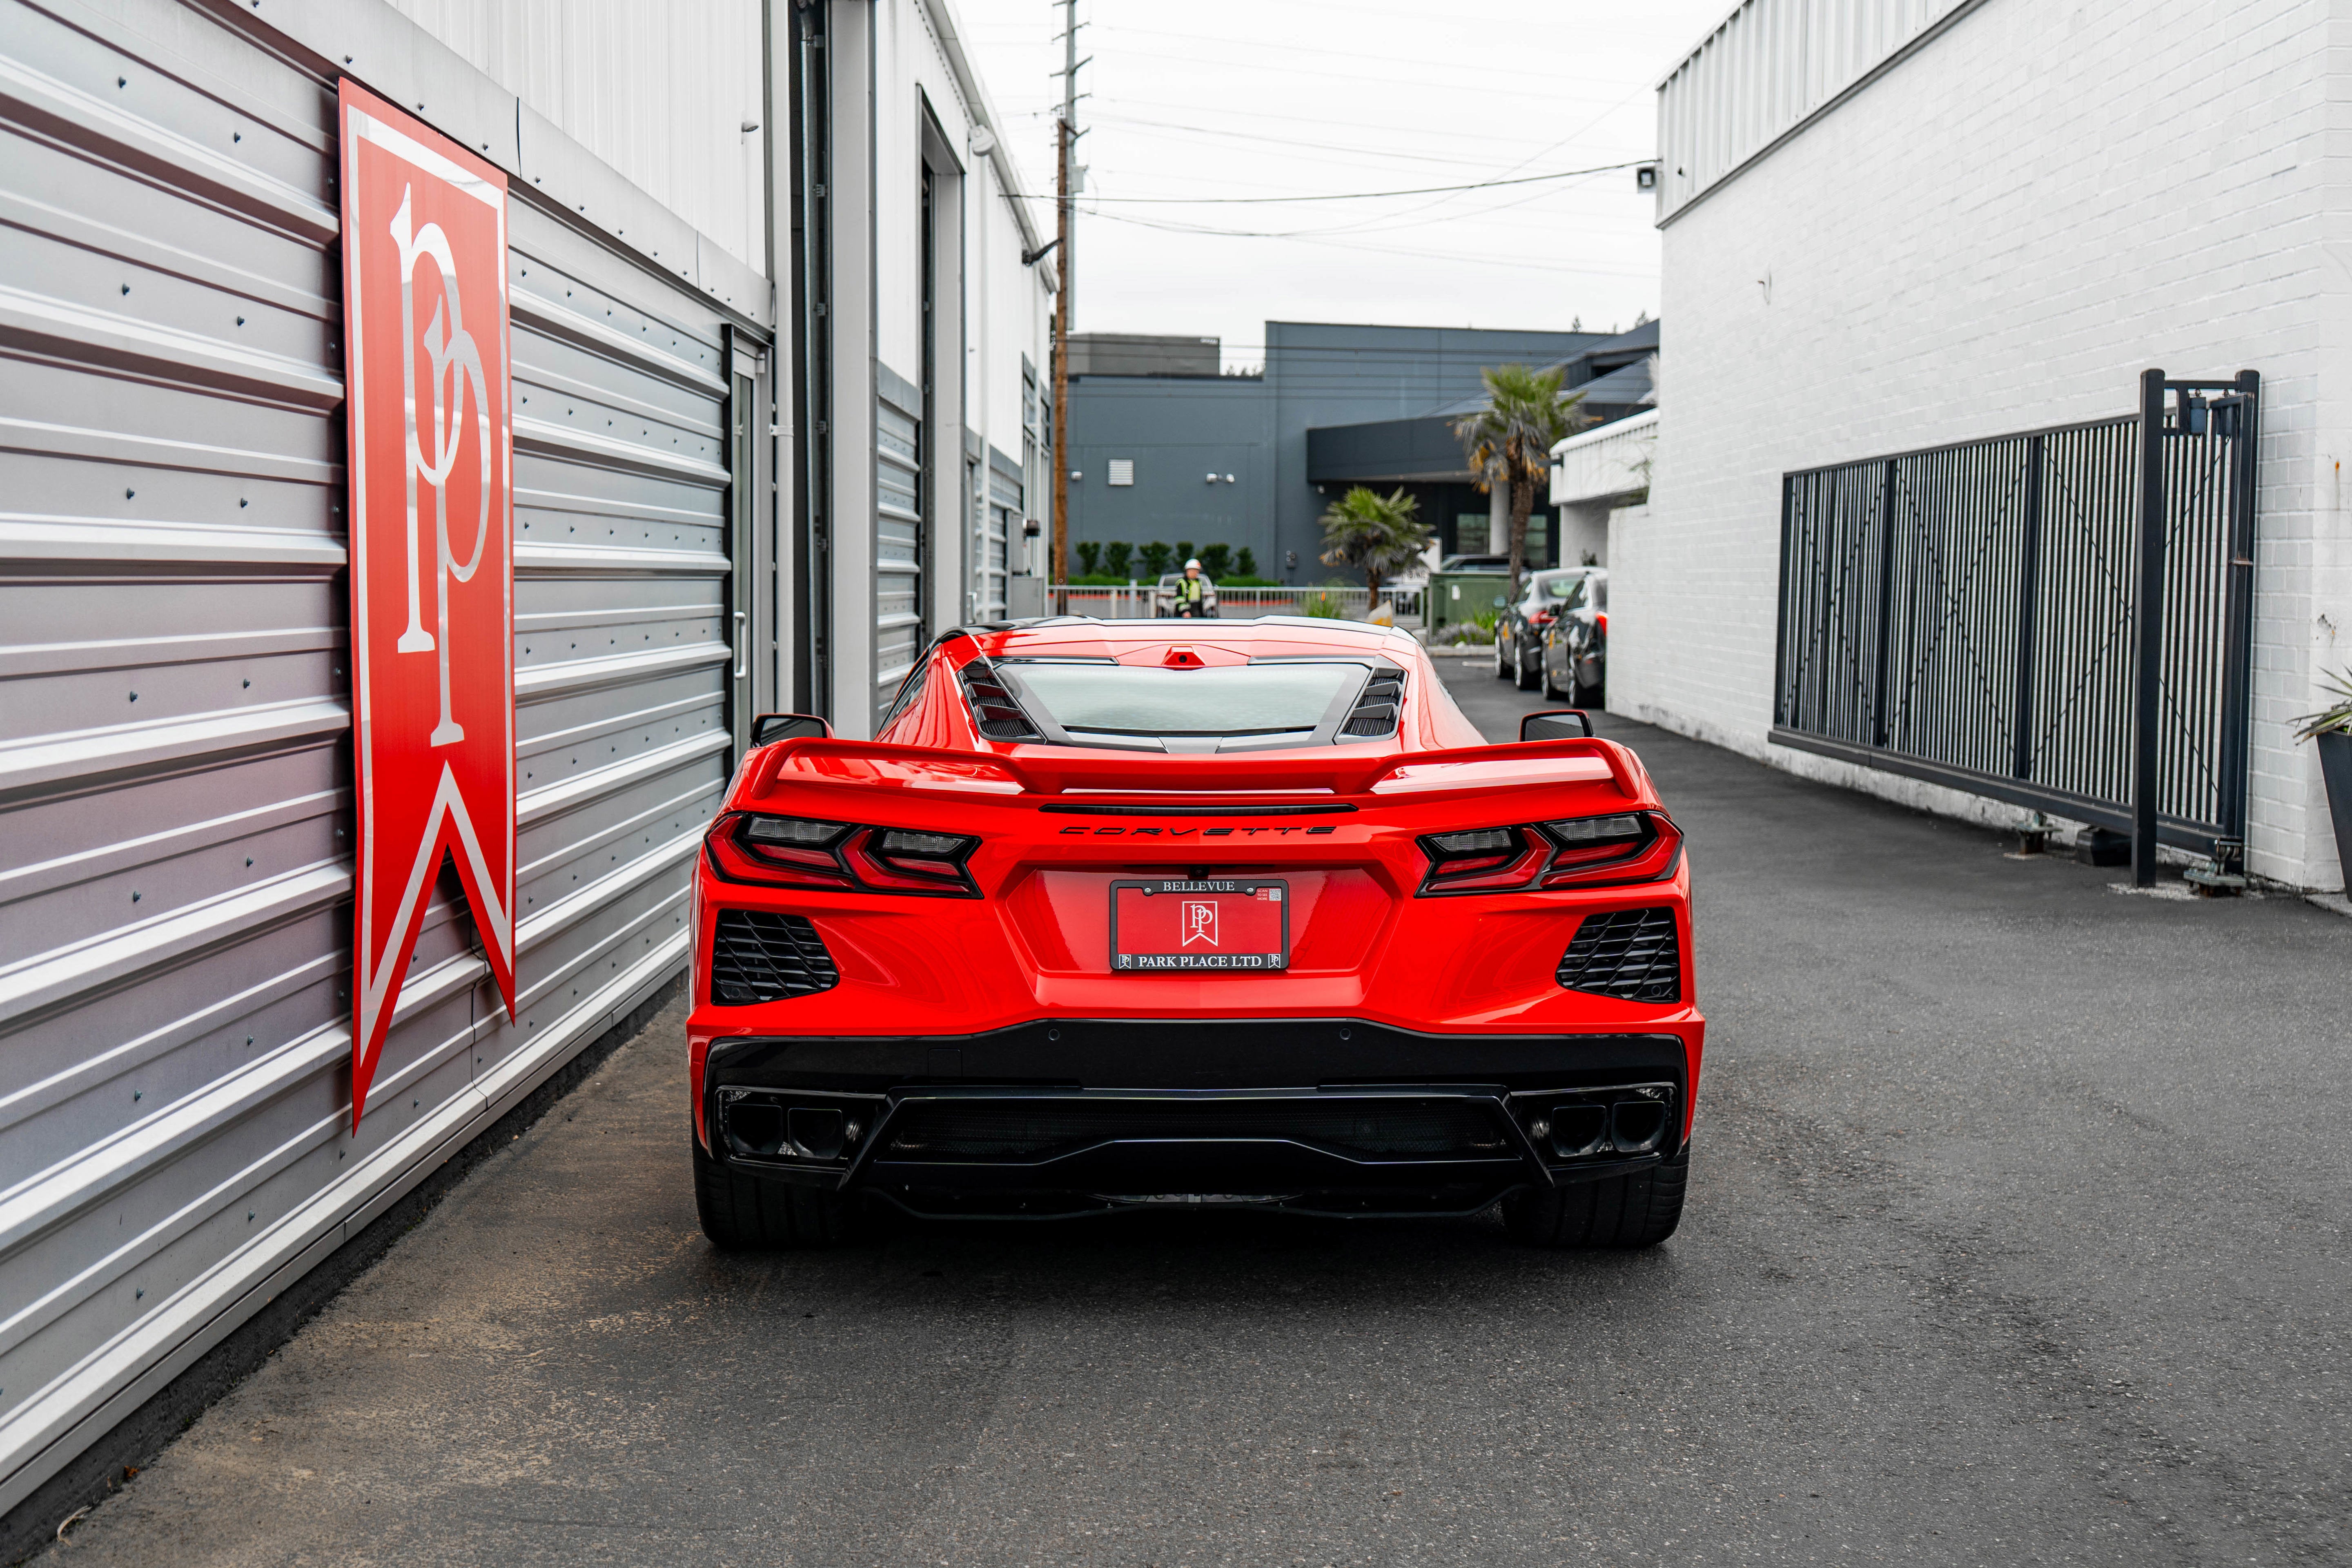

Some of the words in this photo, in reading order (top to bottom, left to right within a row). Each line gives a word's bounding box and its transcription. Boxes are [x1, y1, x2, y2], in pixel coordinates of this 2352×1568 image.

[1059, 826, 1337, 836] CORVETTE
[1163, 881, 1235, 891] BELLEVUE
[1138, 956, 1176, 967] PARK
[1179, 956, 1228, 967] PLACE
[1231, 956, 1262, 967] LTD
